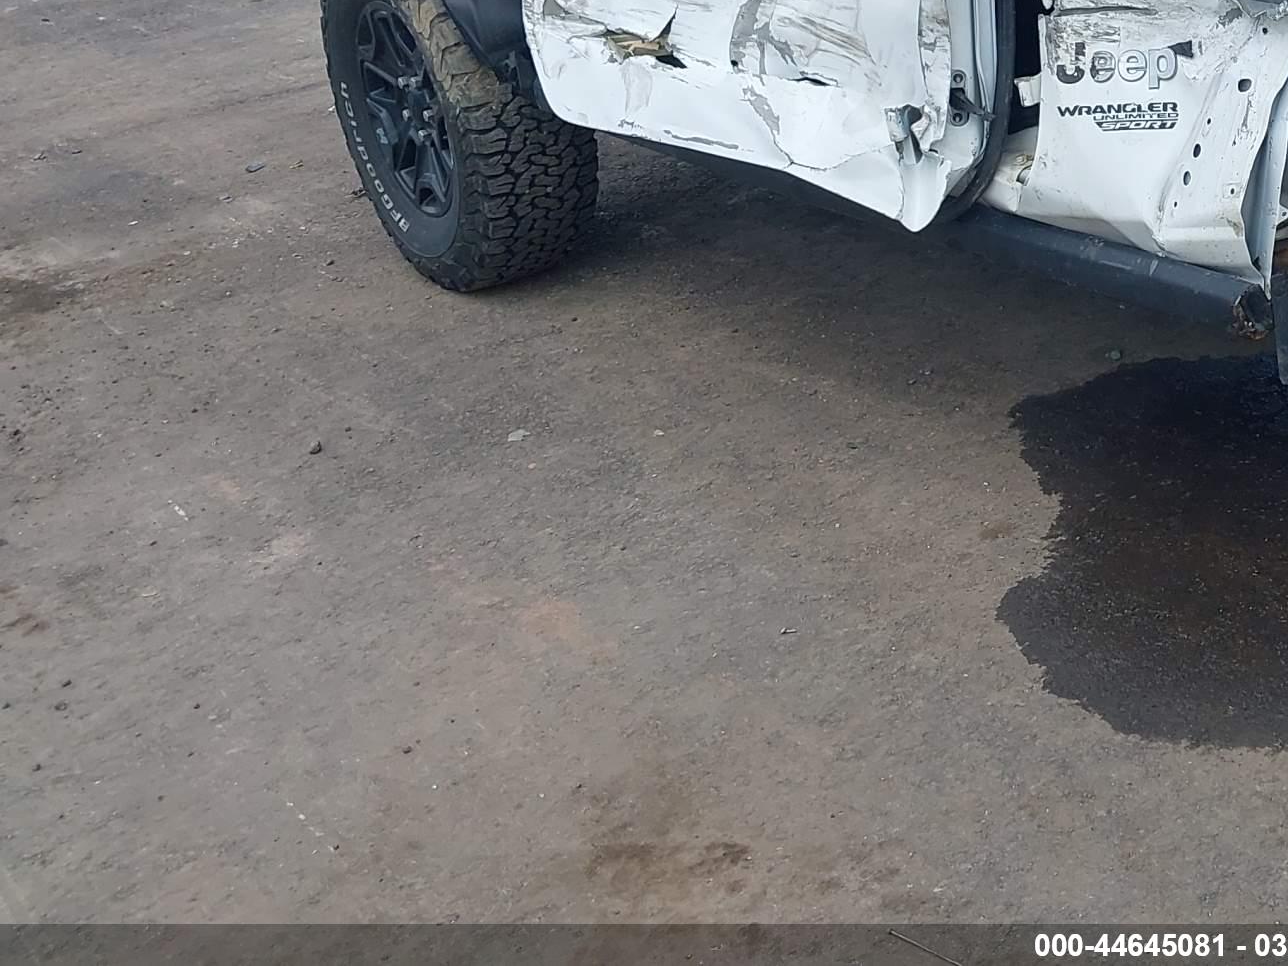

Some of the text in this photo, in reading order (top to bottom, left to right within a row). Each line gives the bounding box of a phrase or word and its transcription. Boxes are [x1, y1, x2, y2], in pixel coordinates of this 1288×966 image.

[1056, 41, 1178, 90] Jeep
[1057, 101, 1179, 117] WRANGLER
[1093, 112, 1179, 121] UNLIMITED
[1101, 120, 1175, 130] SPORT
